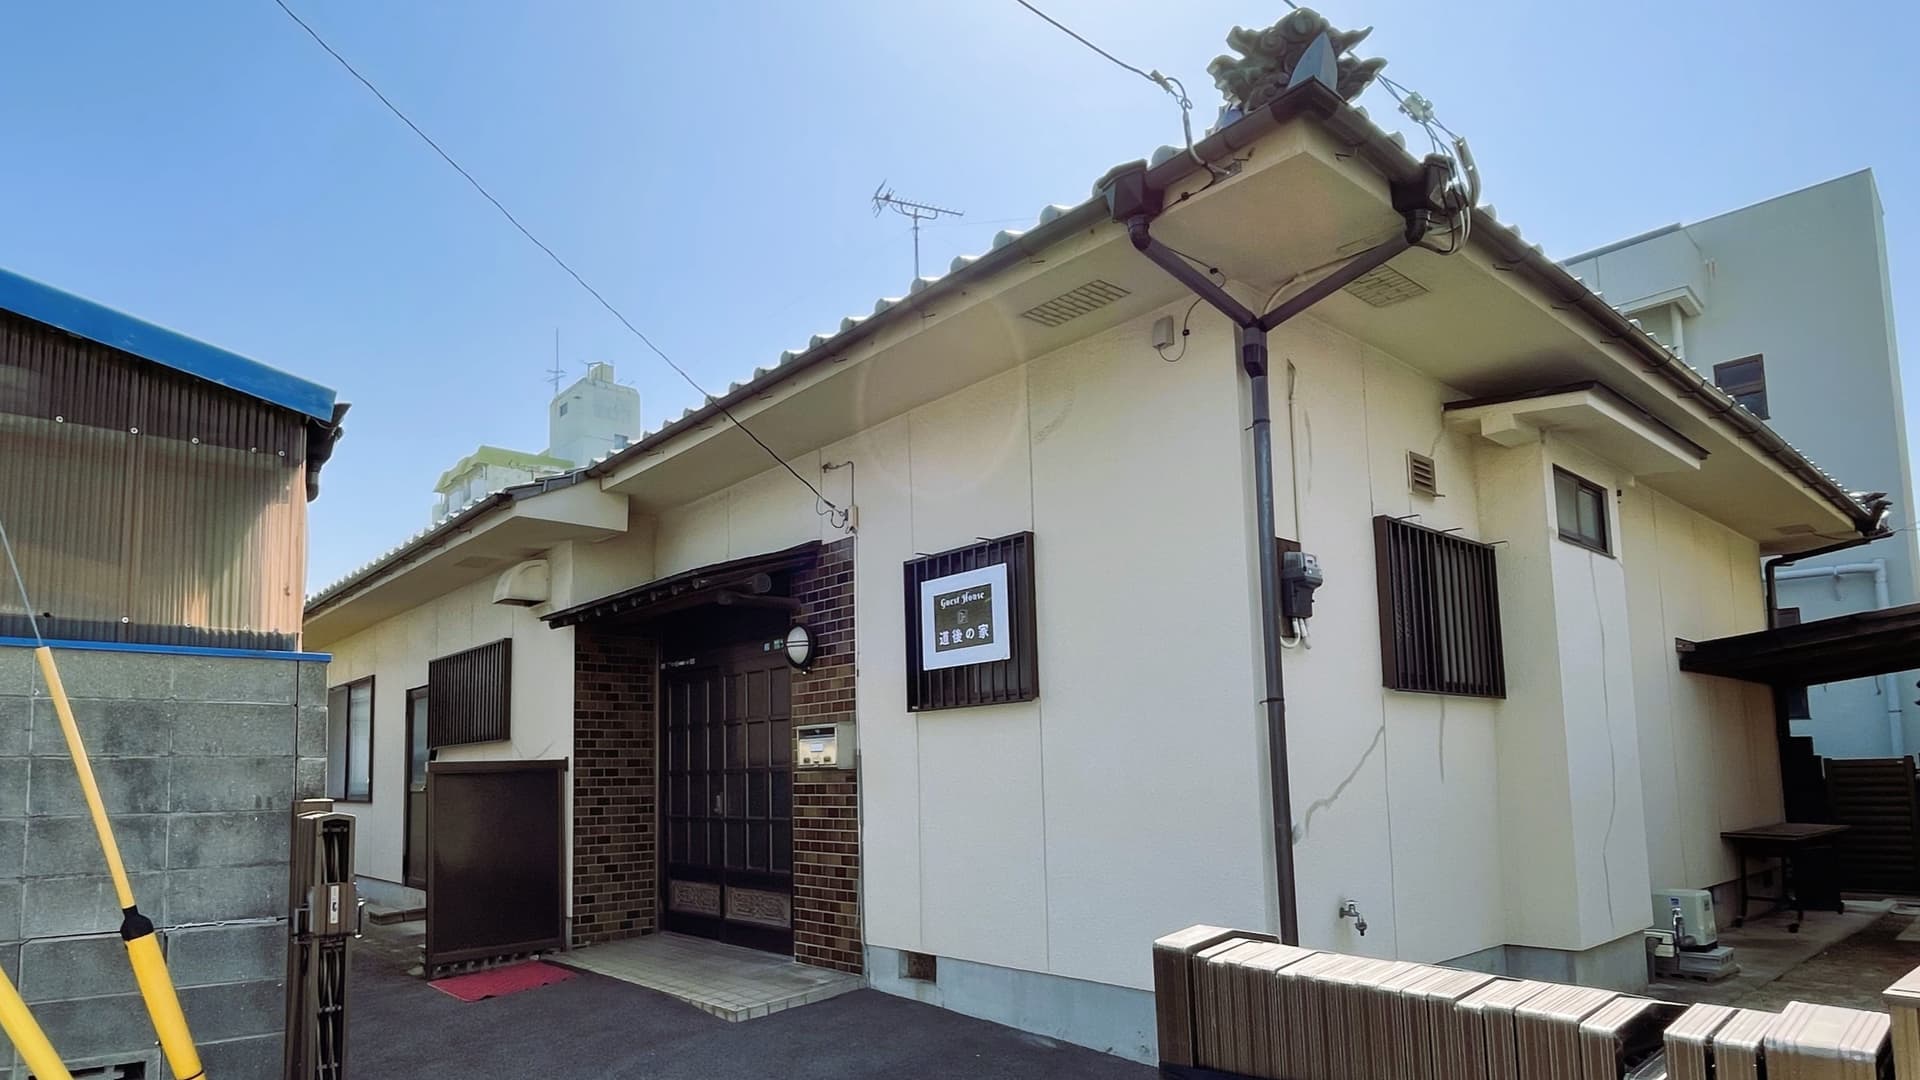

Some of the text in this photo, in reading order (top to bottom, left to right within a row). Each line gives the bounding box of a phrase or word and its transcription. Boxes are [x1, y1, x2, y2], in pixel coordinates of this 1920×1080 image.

[940, 592, 985, 609] Guest House
[939, 623, 990, 645] 道後の家
